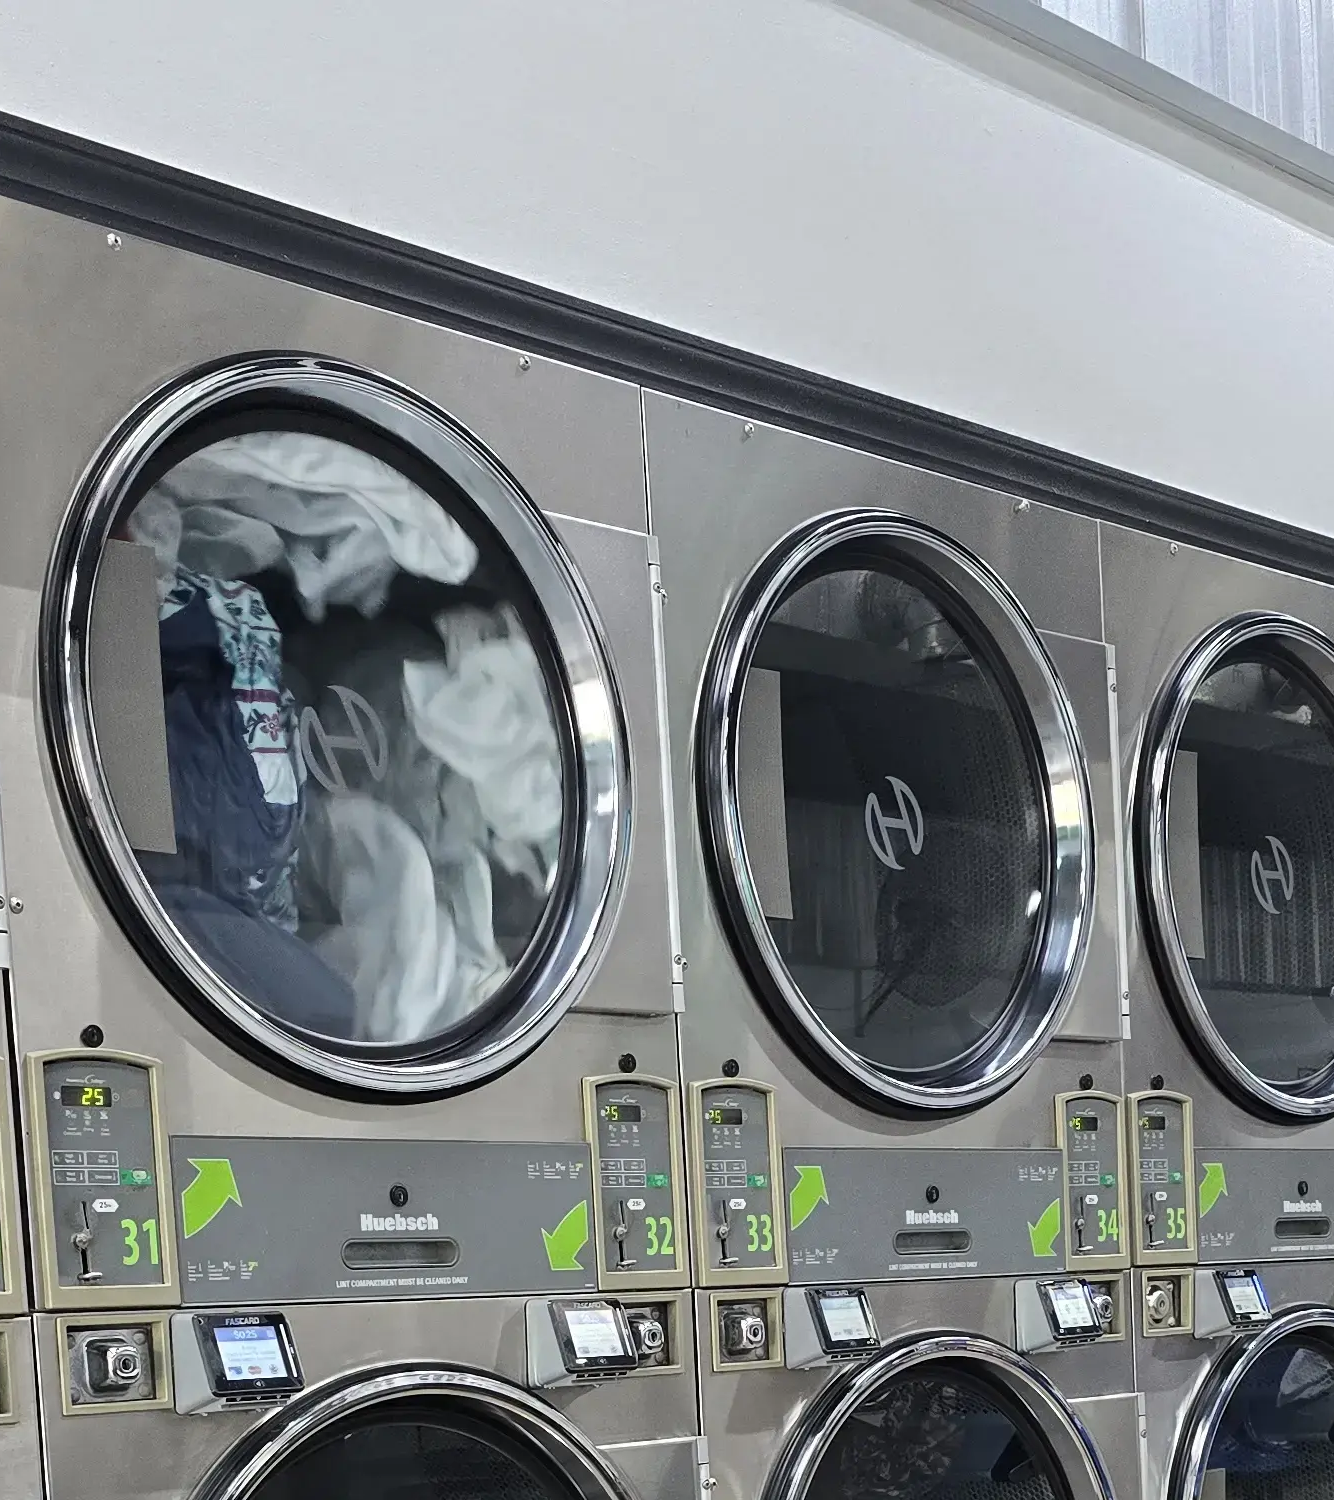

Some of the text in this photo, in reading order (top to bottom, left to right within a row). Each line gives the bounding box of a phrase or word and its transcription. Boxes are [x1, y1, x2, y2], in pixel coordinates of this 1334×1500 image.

[81, 1087, 104, 1106] 25
[360, 1213, 439, 1231] Huebsch
[746, 1214, 773, 1252] 33
[905, 1209, 959, 1225] Huebsch
[1097, 1209, 1119, 1242] 34
[1166, 1207, 1186, 1239] 35
[120, 1218, 159, 1266] 31
[645, 1216, 674, 1256] 32
[225, 1316, 260, 1326] FASCARD
